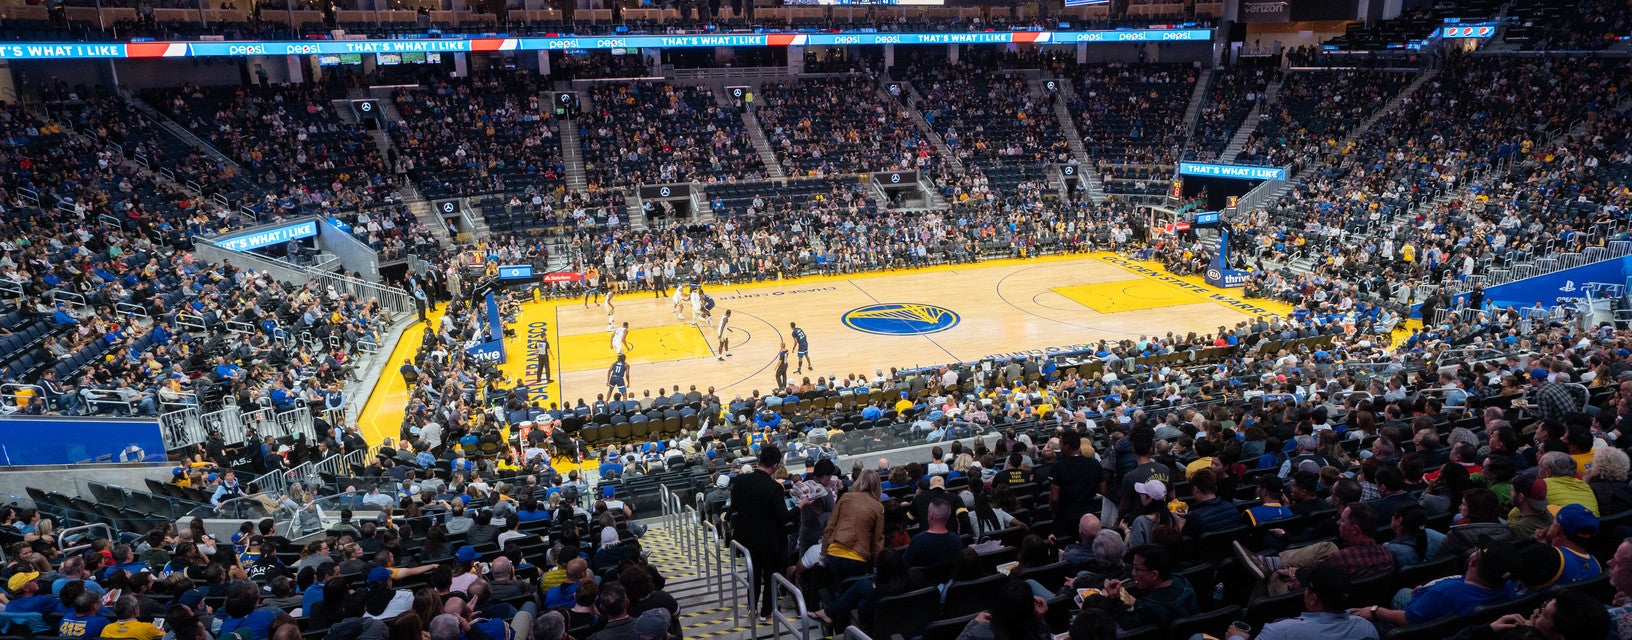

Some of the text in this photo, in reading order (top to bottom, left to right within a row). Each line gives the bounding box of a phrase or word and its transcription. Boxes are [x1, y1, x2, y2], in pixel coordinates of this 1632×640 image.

[662, 37, 698, 46] THAT'S
[700, 37, 732, 45] WHAT
[739, 36, 761, 44] LIKE
[834, 35, 861, 45] pepsi
[875, 35, 901, 45] pepsi
[918, 34, 949, 42] THAT'S
[951, 34, 978, 42] WHAT
[985, 34, 1007, 42] LIKE
[1077, 32, 1104, 42] pepsi
[1119, 32, 1147, 42] pepsi
[1163, 31, 1191, 41] pepsi
[229, 43, 266, 55] pepsi
[287, 43, 321, 55] pepsi
[346, 42, 391, 52] THAT'S
[393, 42, 429, 51] WHAT
[438, 41, 464, 50] LIKE
[550, 38, 580, 49] pepsi
[597, 38, 627, 49] pepsi
[27, 46, 72, 57] WHAT
[77, 46, 83, 56] I
[90, 45, 119, 56] LIKE
[1188, 165, 1220, 175] THAT'S
[1222, 167, 1250, 176] WHAT
[1257, 168, 1278, 178] LIKE
[250, 231, 281, 246] WHAT
[289, 224, 312, 237] LIKE
[1102, 256, 1164, 277] GOLDEN
[1159, 276, 1210, 294] STATE
[60, 621, 86, 636] 415
